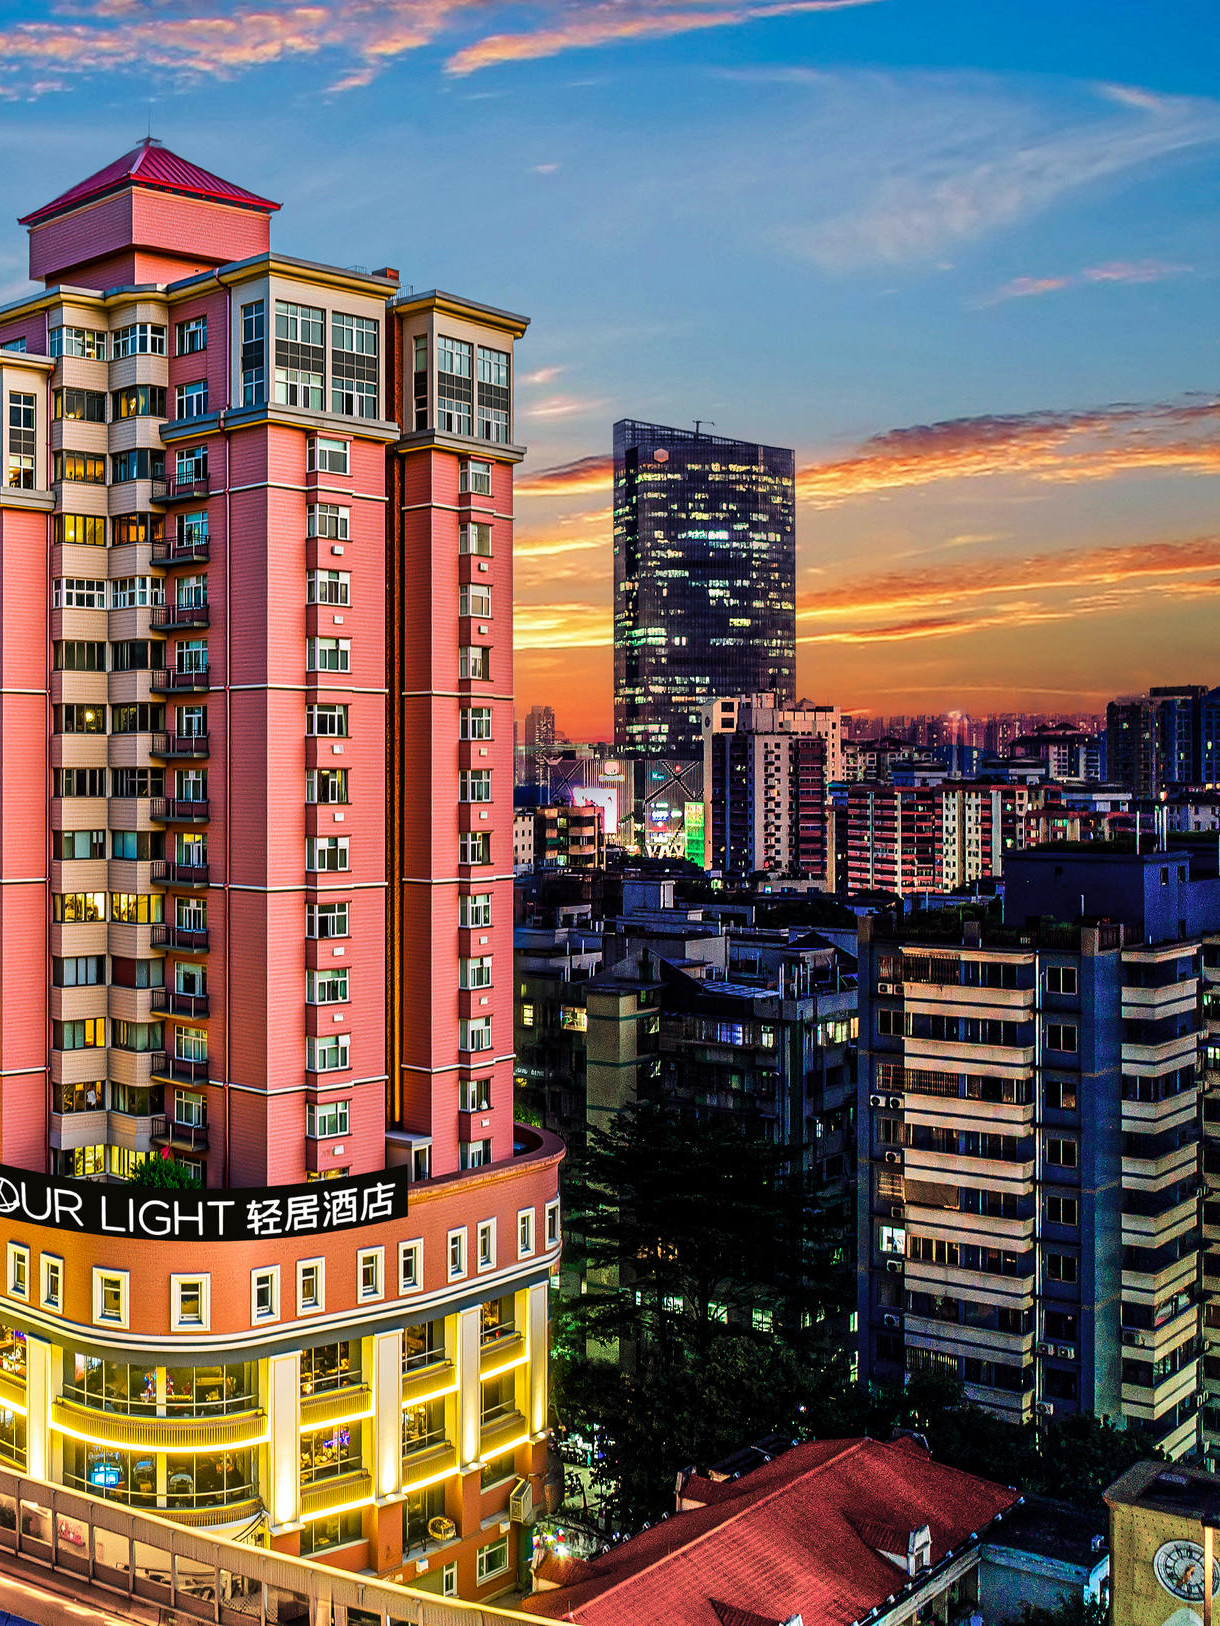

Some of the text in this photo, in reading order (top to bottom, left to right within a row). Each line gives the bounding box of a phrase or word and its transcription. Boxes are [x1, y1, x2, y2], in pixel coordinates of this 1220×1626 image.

[101, 1195, 235, 1236] LIGHT
[246, 1181, 396, 1235] 轻居酒店
